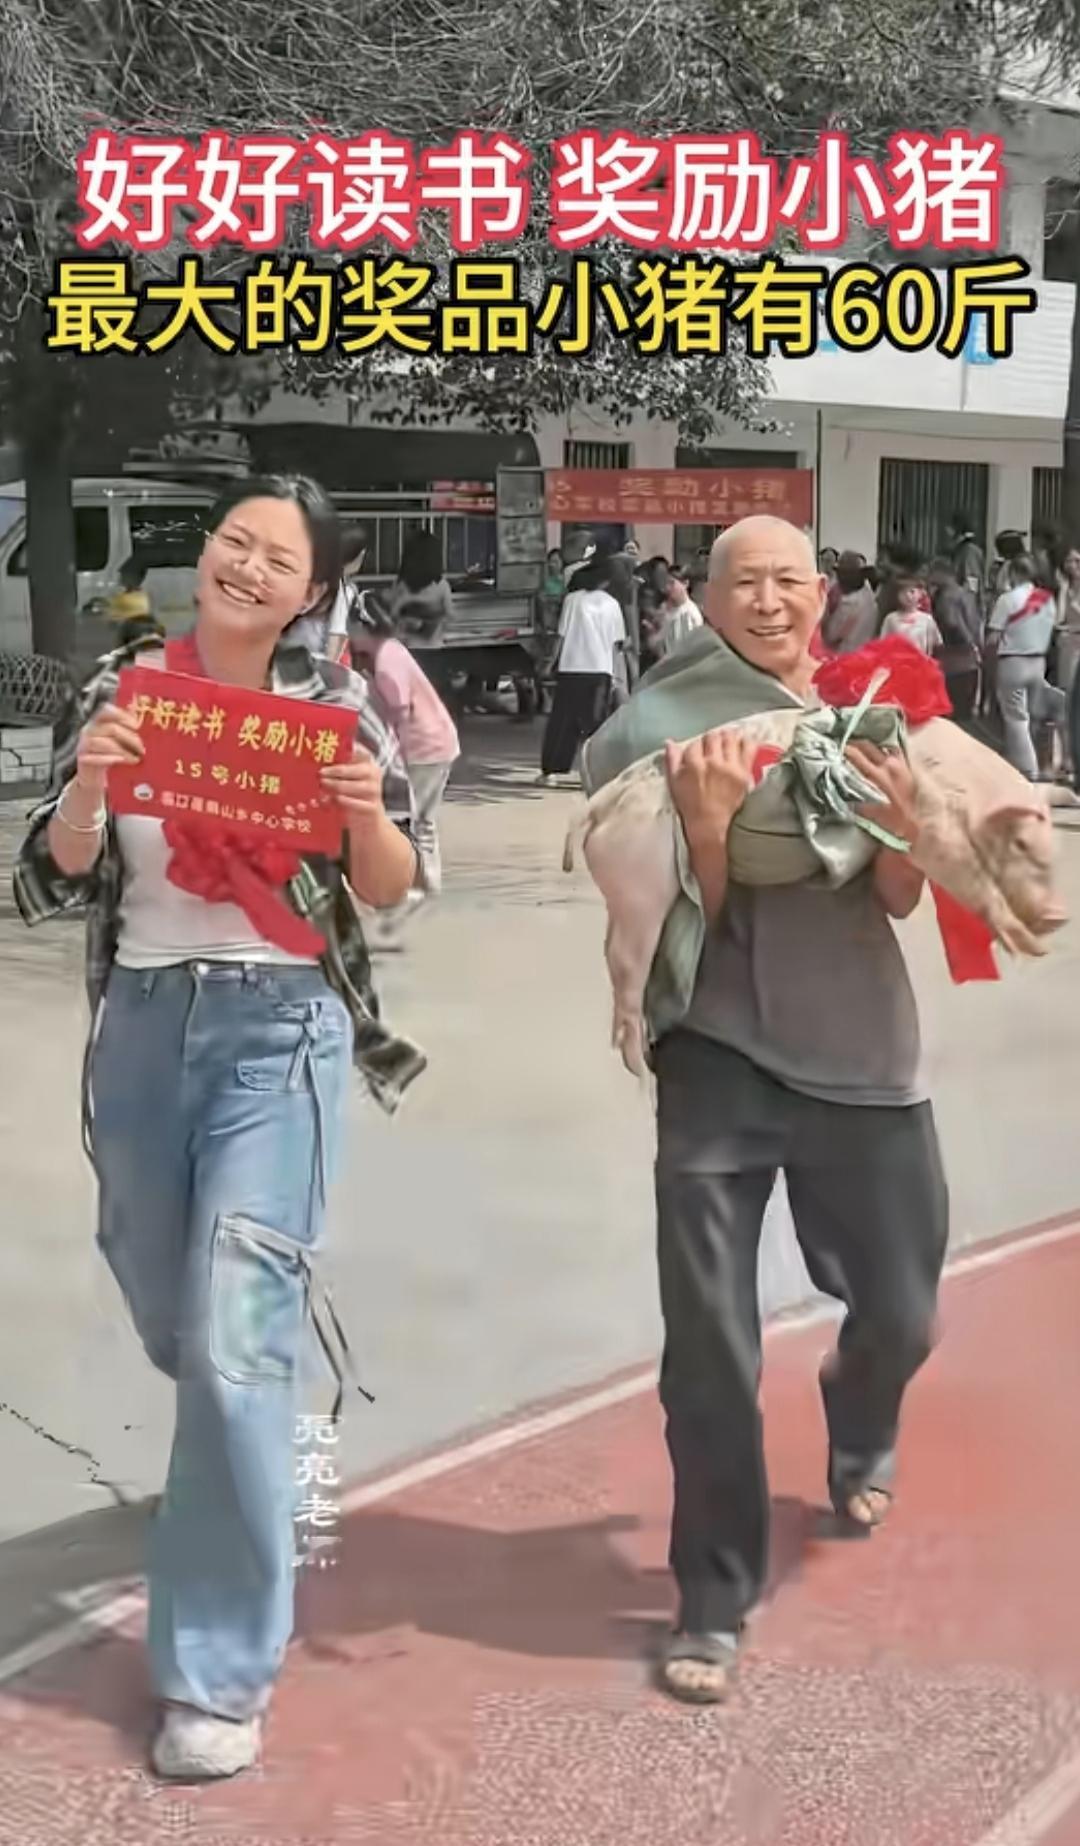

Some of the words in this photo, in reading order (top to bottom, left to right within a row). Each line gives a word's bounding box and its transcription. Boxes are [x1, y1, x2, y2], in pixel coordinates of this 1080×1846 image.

[128, 692, 227, 741] 好好读书
[238, 714, 340, 763] 奖励小猪
